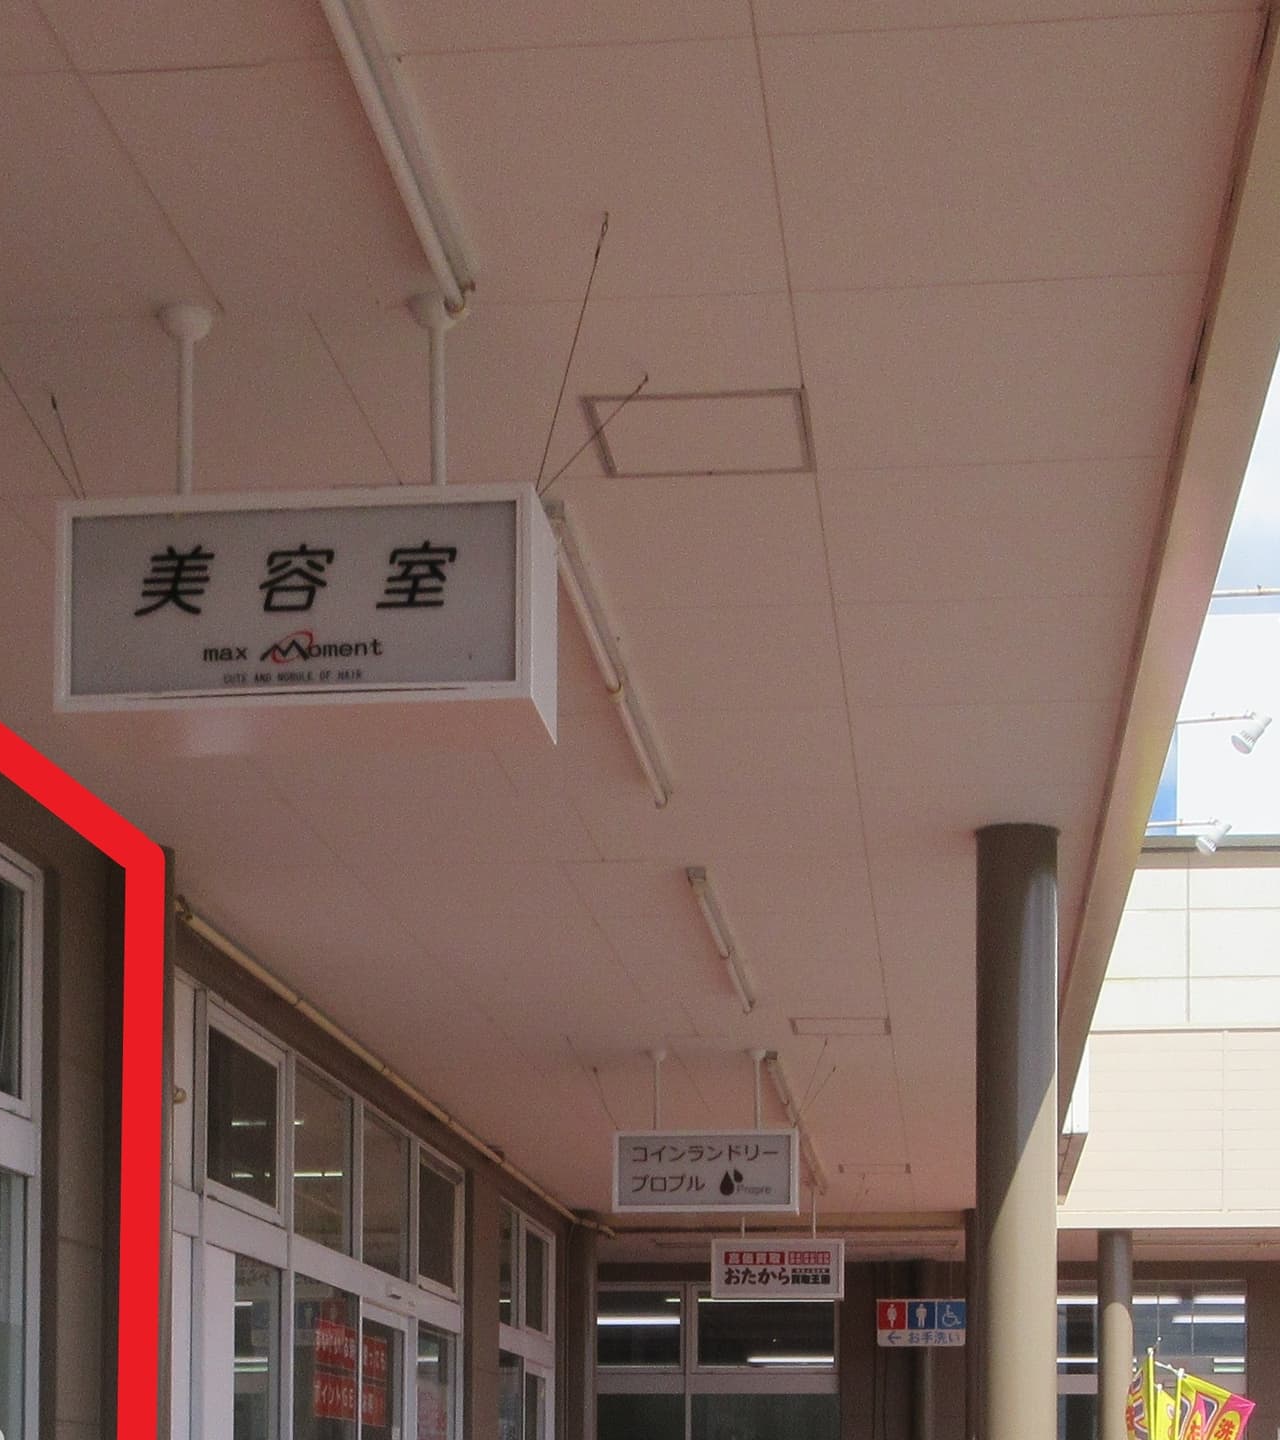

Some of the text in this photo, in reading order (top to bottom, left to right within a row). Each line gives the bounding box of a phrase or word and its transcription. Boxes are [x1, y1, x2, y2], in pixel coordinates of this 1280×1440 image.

[134, 540, 458, 617] 美容室
[203, 646, 249, 662] max
[631, 1143, 780, 1163] コインランドリー
[724, 1266, 790, 1286] おたから
